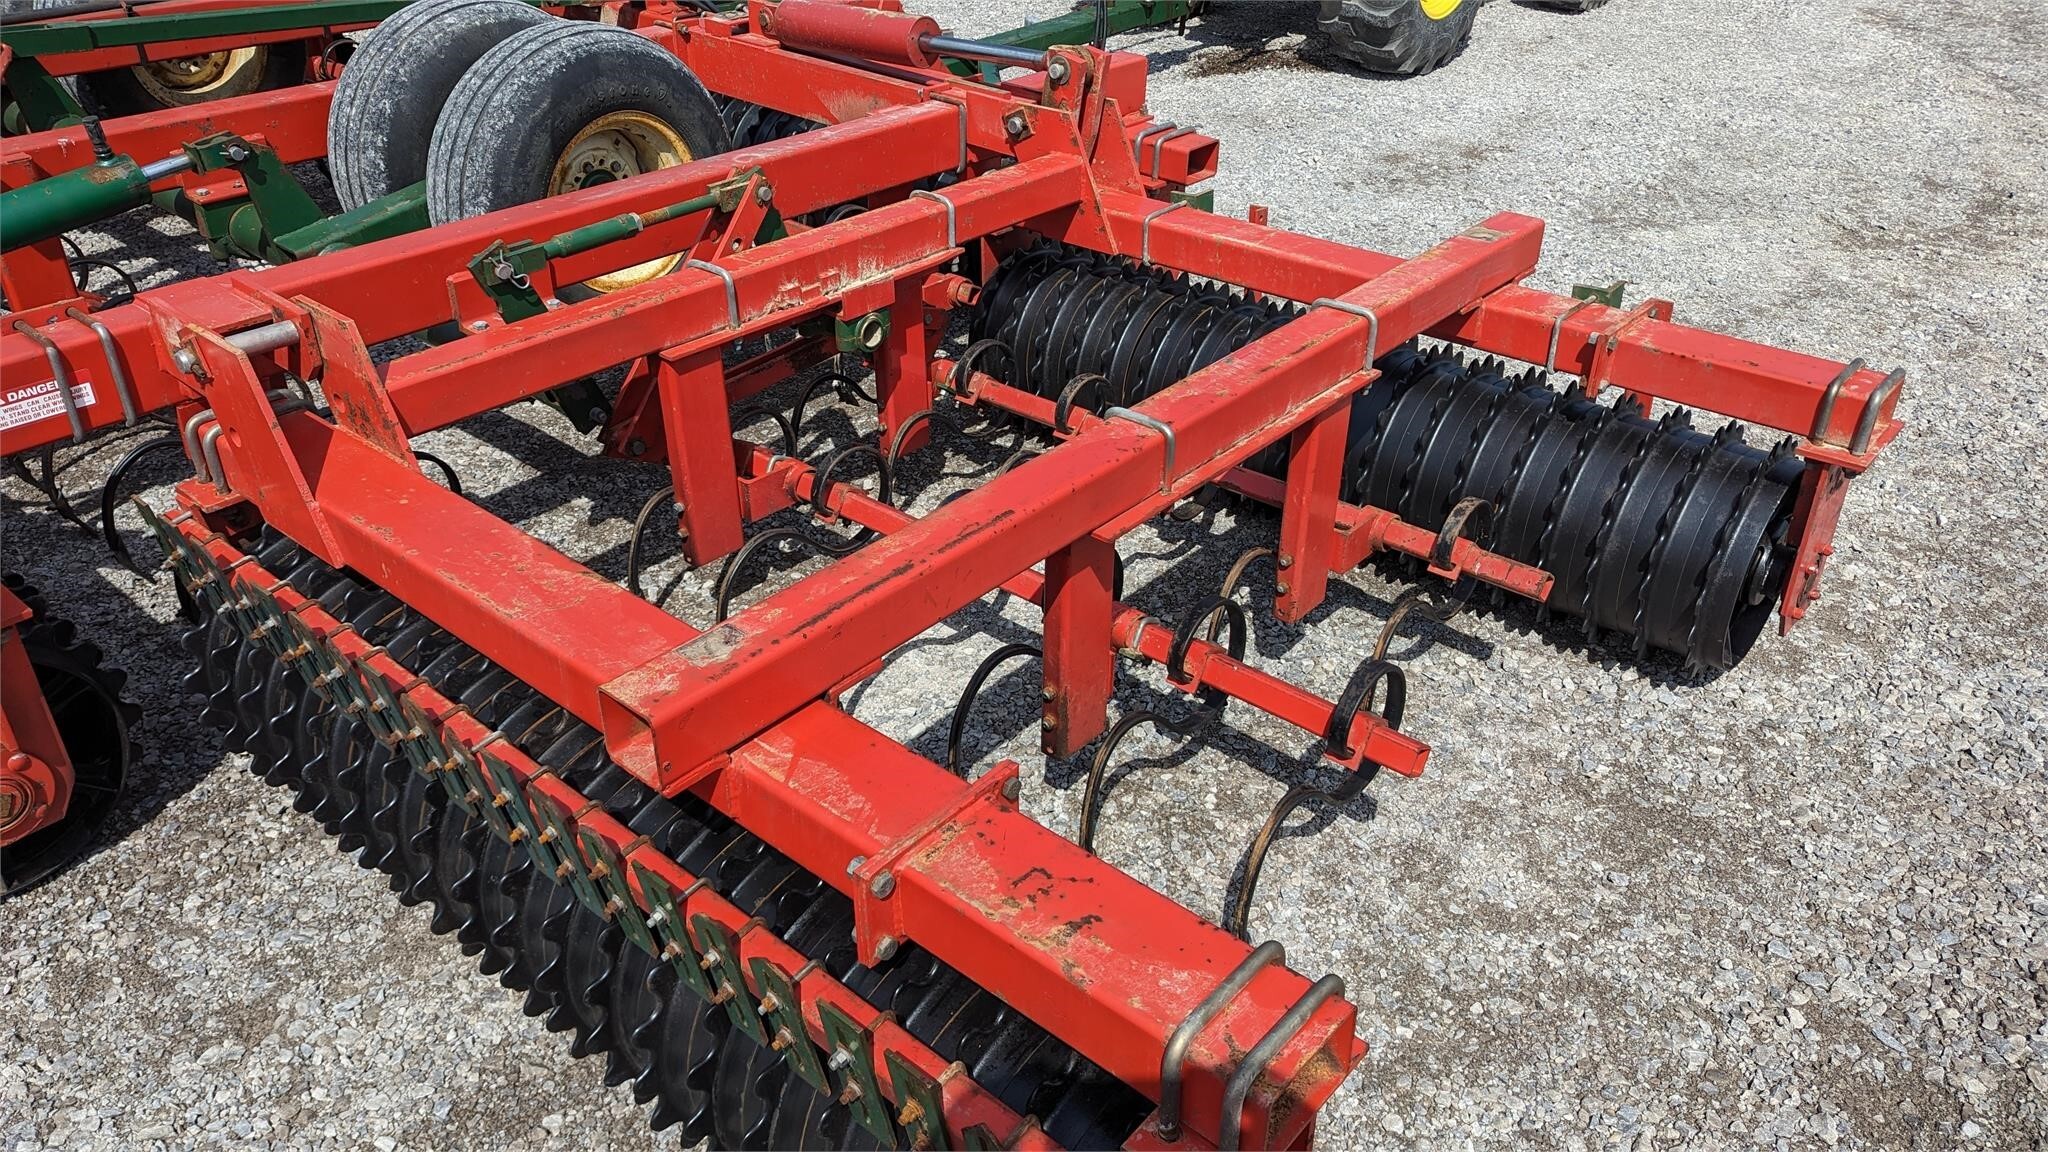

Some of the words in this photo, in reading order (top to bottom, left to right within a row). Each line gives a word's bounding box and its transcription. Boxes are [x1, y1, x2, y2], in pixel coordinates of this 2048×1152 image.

[3, 404, 23, 413] WINGS
[9, 409, 30, 419] STAND
[31, 403, 51, 413] CLEAR
[10, 415, 33, 425] RAISED
[33, 411, 42, 419] OR
[43, 405, 66, 416] LOWERE
